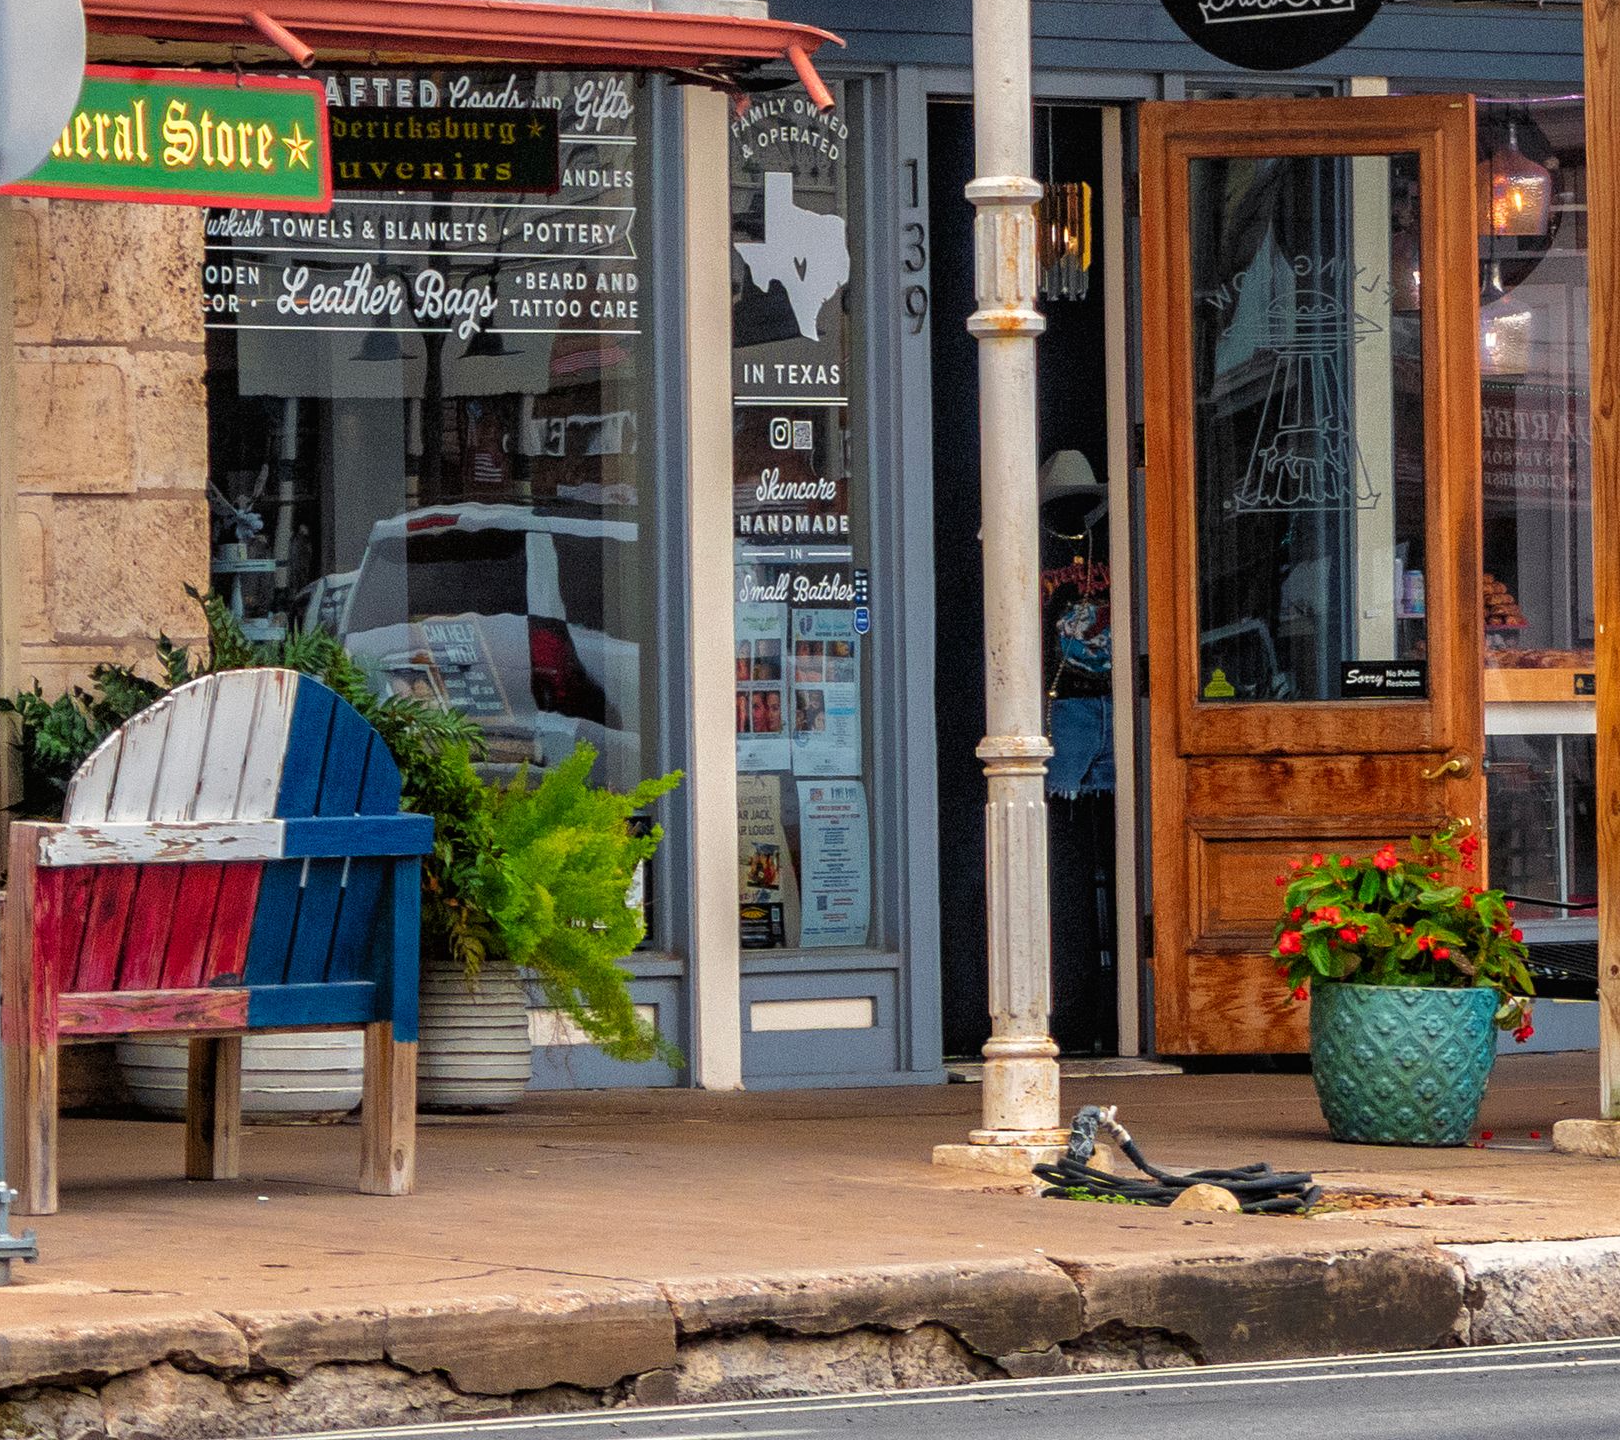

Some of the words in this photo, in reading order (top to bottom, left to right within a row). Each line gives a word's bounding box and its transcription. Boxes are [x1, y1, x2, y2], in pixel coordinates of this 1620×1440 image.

[531, 94, 563, 110] AND
[574, 78, 634, 132] Gifts
[333, 115, 516, 144] dericksburg
[731, 98, 787, 139] FAMILY
[52, 100, 148, 163] neral
[161, 98, 274, 170] Store
[741, 143, 754, 160] &
[758, 126, 840, 162] OPERATED
[338, 157, 513, 181] uvenirs
[561, 167, 634, 189] ANDLES
[271, 216, 353, 239] TOWELS
[361, 221, 376, 239] &
[384, 221, 488, 243] BLANKETS
[522, 223, 618, 244] POTTERY
[204, 268, 260, 286] ODEN
[525, 271, 587, 291] BEARD
[596, 272, 639, 292] AND
[277, 262, 404, 318] Leather
[414, 267, 499, 340] Bags
[509, 299, 583, 319] TATTOO
[589, 300, 639, 319] CARE
[743, 363, 766, 385] IN
[774, 363, 841, 386] TEXAS
[756, 468, 837, 502] Skincare
[739, 515, 850, 535] HANDMADE
[790, 548, 803, 560] IN
[739, 573, 790, 603] Small
[792, 573, 857, 603] Batches
[1345, 668, 1384, 688] Sorry
[1385, 669, 1397, 678] No
[1397, 669, 1421, 679] Public
[1385, 679, 1421, 688] Restroom
